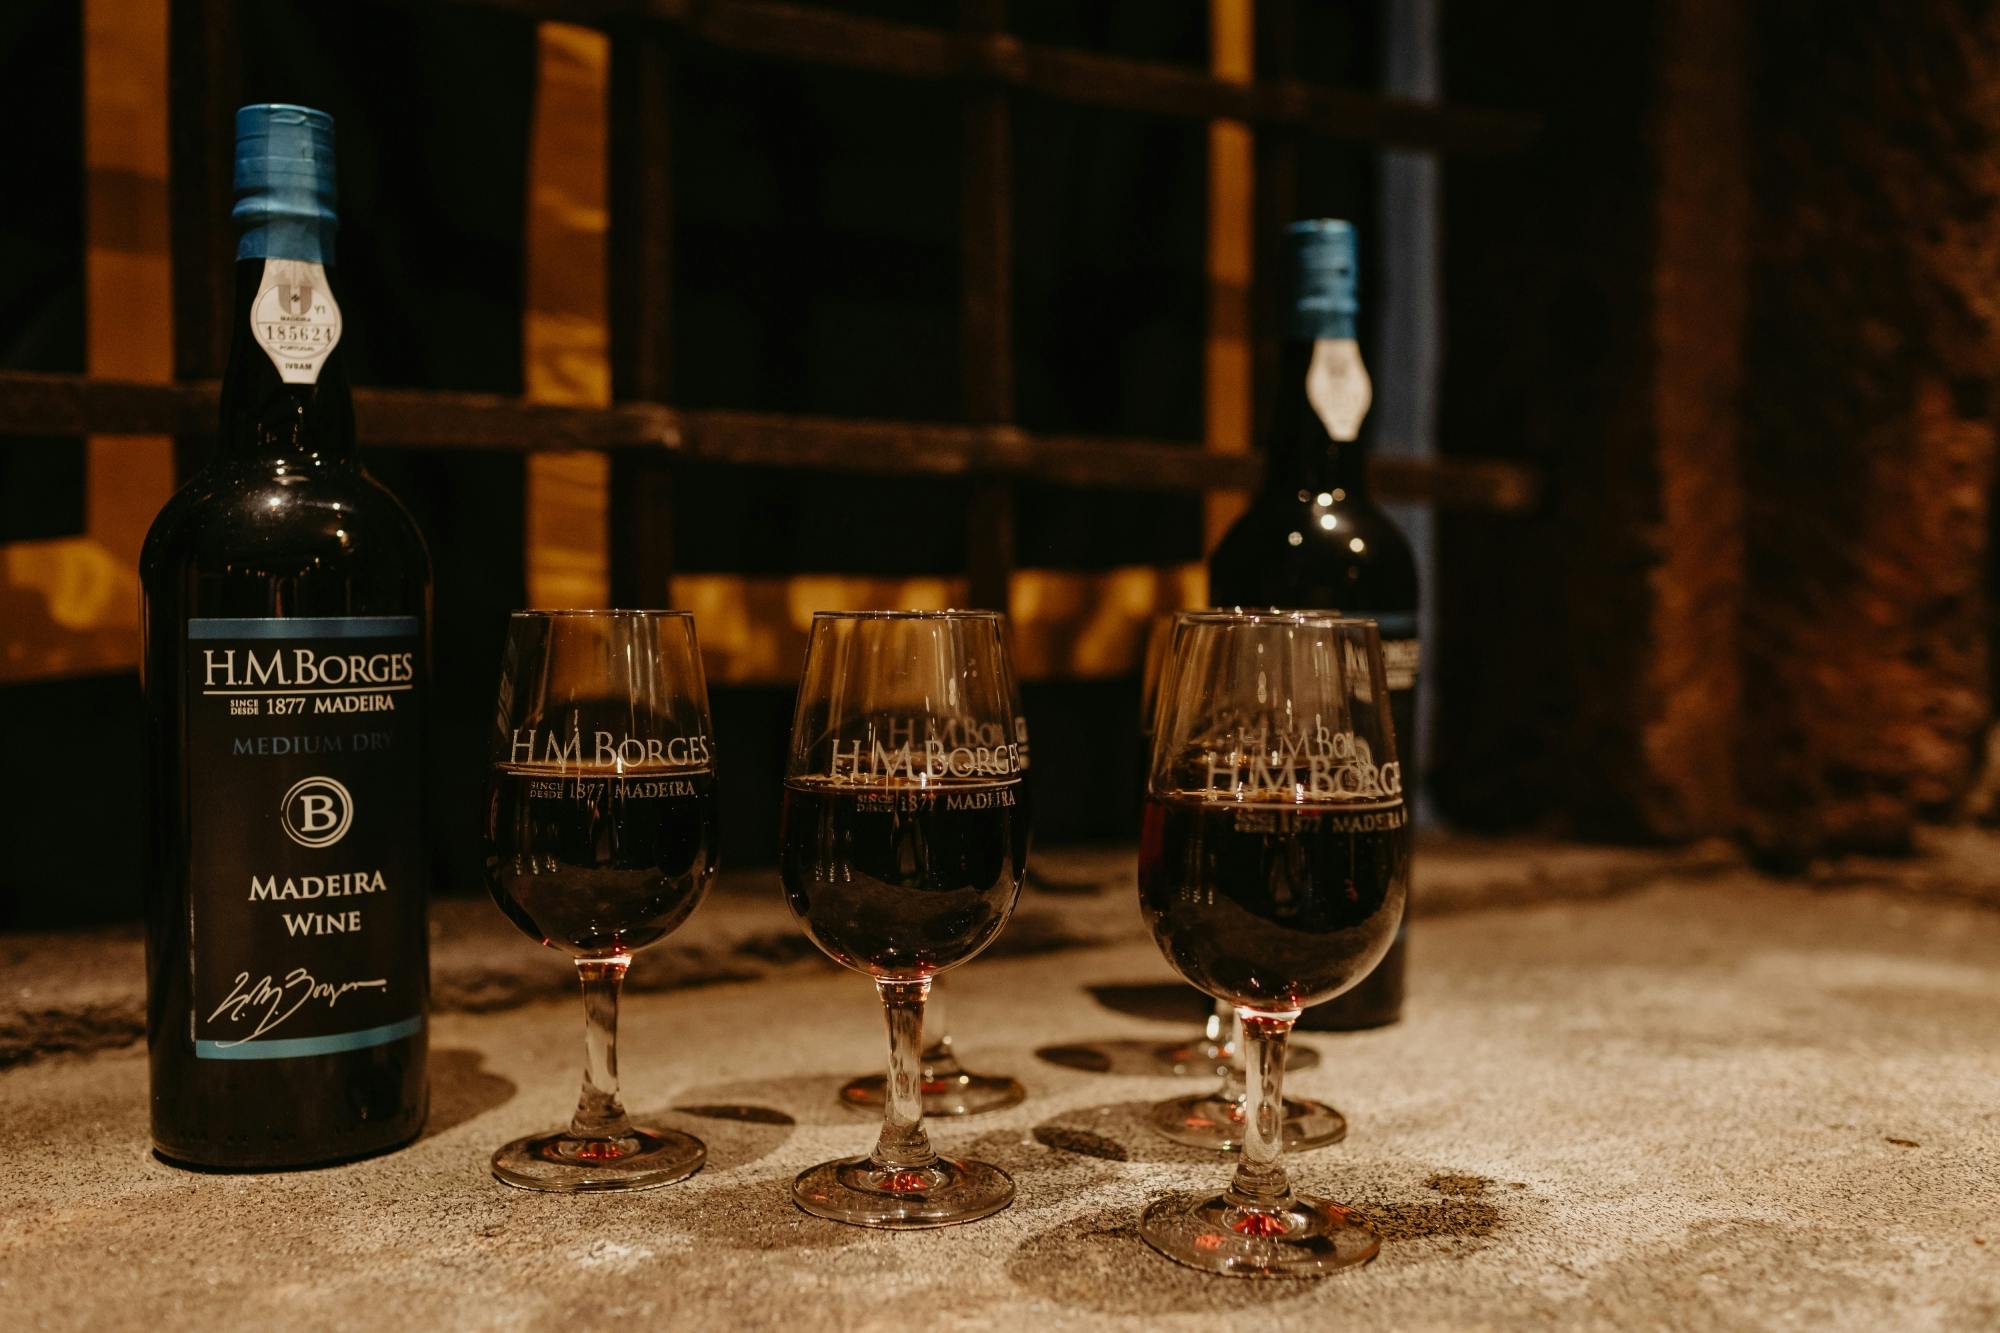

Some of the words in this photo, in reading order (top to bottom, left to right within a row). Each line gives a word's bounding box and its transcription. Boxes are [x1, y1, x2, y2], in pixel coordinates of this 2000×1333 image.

[266, 325, 334, 342] 185624
[230, 699, 259, 707] SINCE
[266, 698, 306, 715] 1877
[313, 694, 395, 714] MADEIRA
[230, 707, 259, 715] DESDE
[233, 736, 343, 756] MEDIUM
[353, 732, 393, 752] DRY
[570, 783, 605, 800] 1877
[614, 781, 696, 799] MADEIRA
[301, 795, 338, 832] B
[248, 870, 387, 901] MADEIRA
[282, 911, 361, 937] WINE
